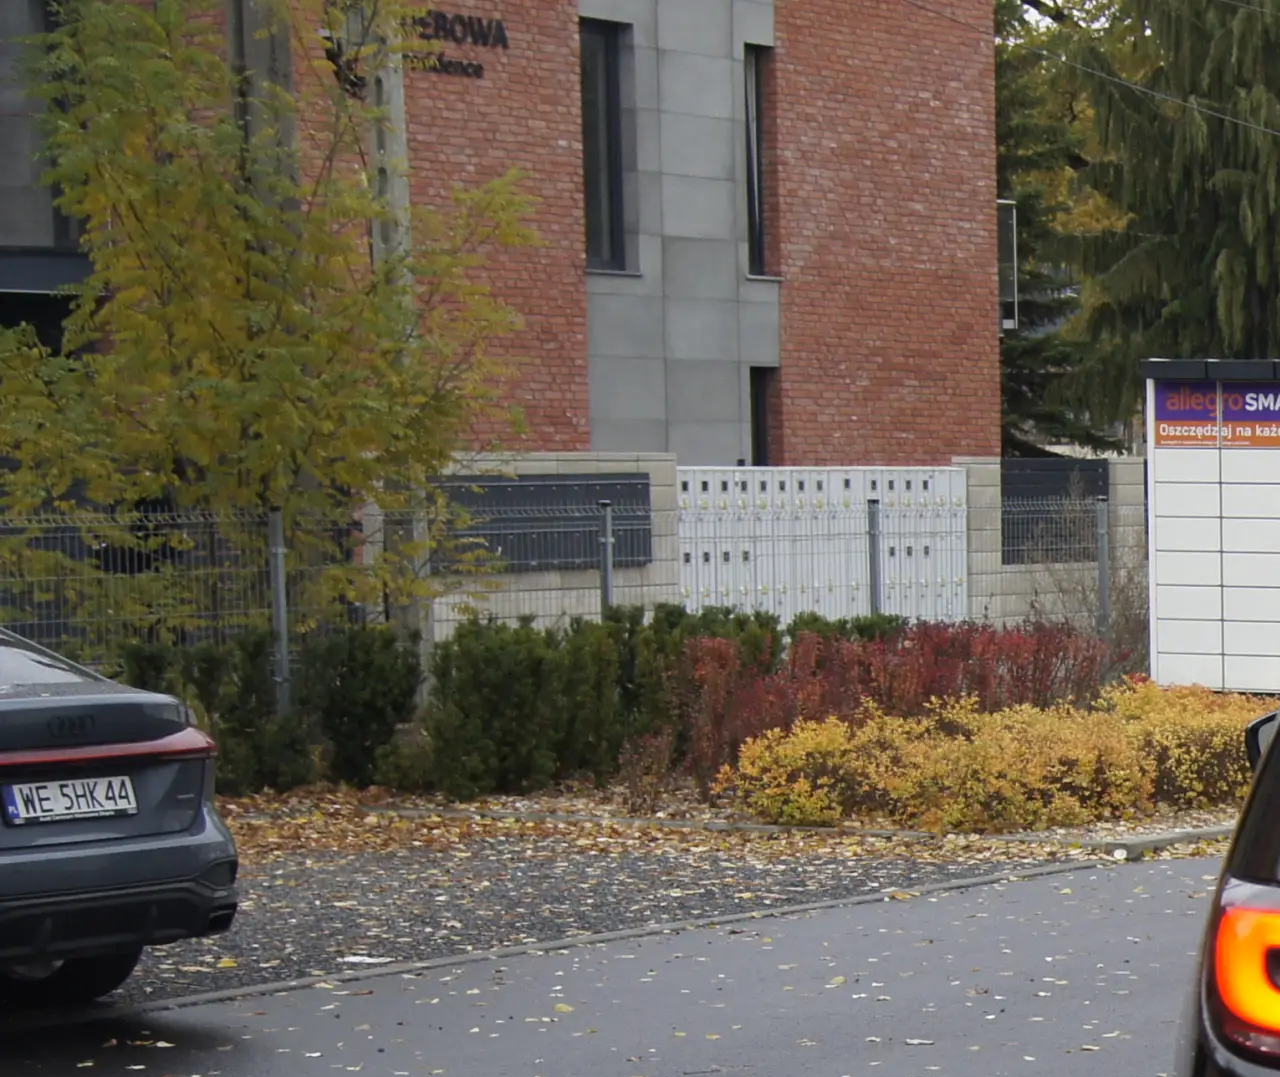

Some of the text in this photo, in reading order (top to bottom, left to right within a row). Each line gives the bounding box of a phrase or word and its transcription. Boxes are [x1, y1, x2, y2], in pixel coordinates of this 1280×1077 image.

[1166, 386, 1243, 417] allegro
[1159, 423, 1232, 439] Oszczędzaj
[1236, 427, 1252, 437] na
[19, 779, 131, 815] WE 5HK44
